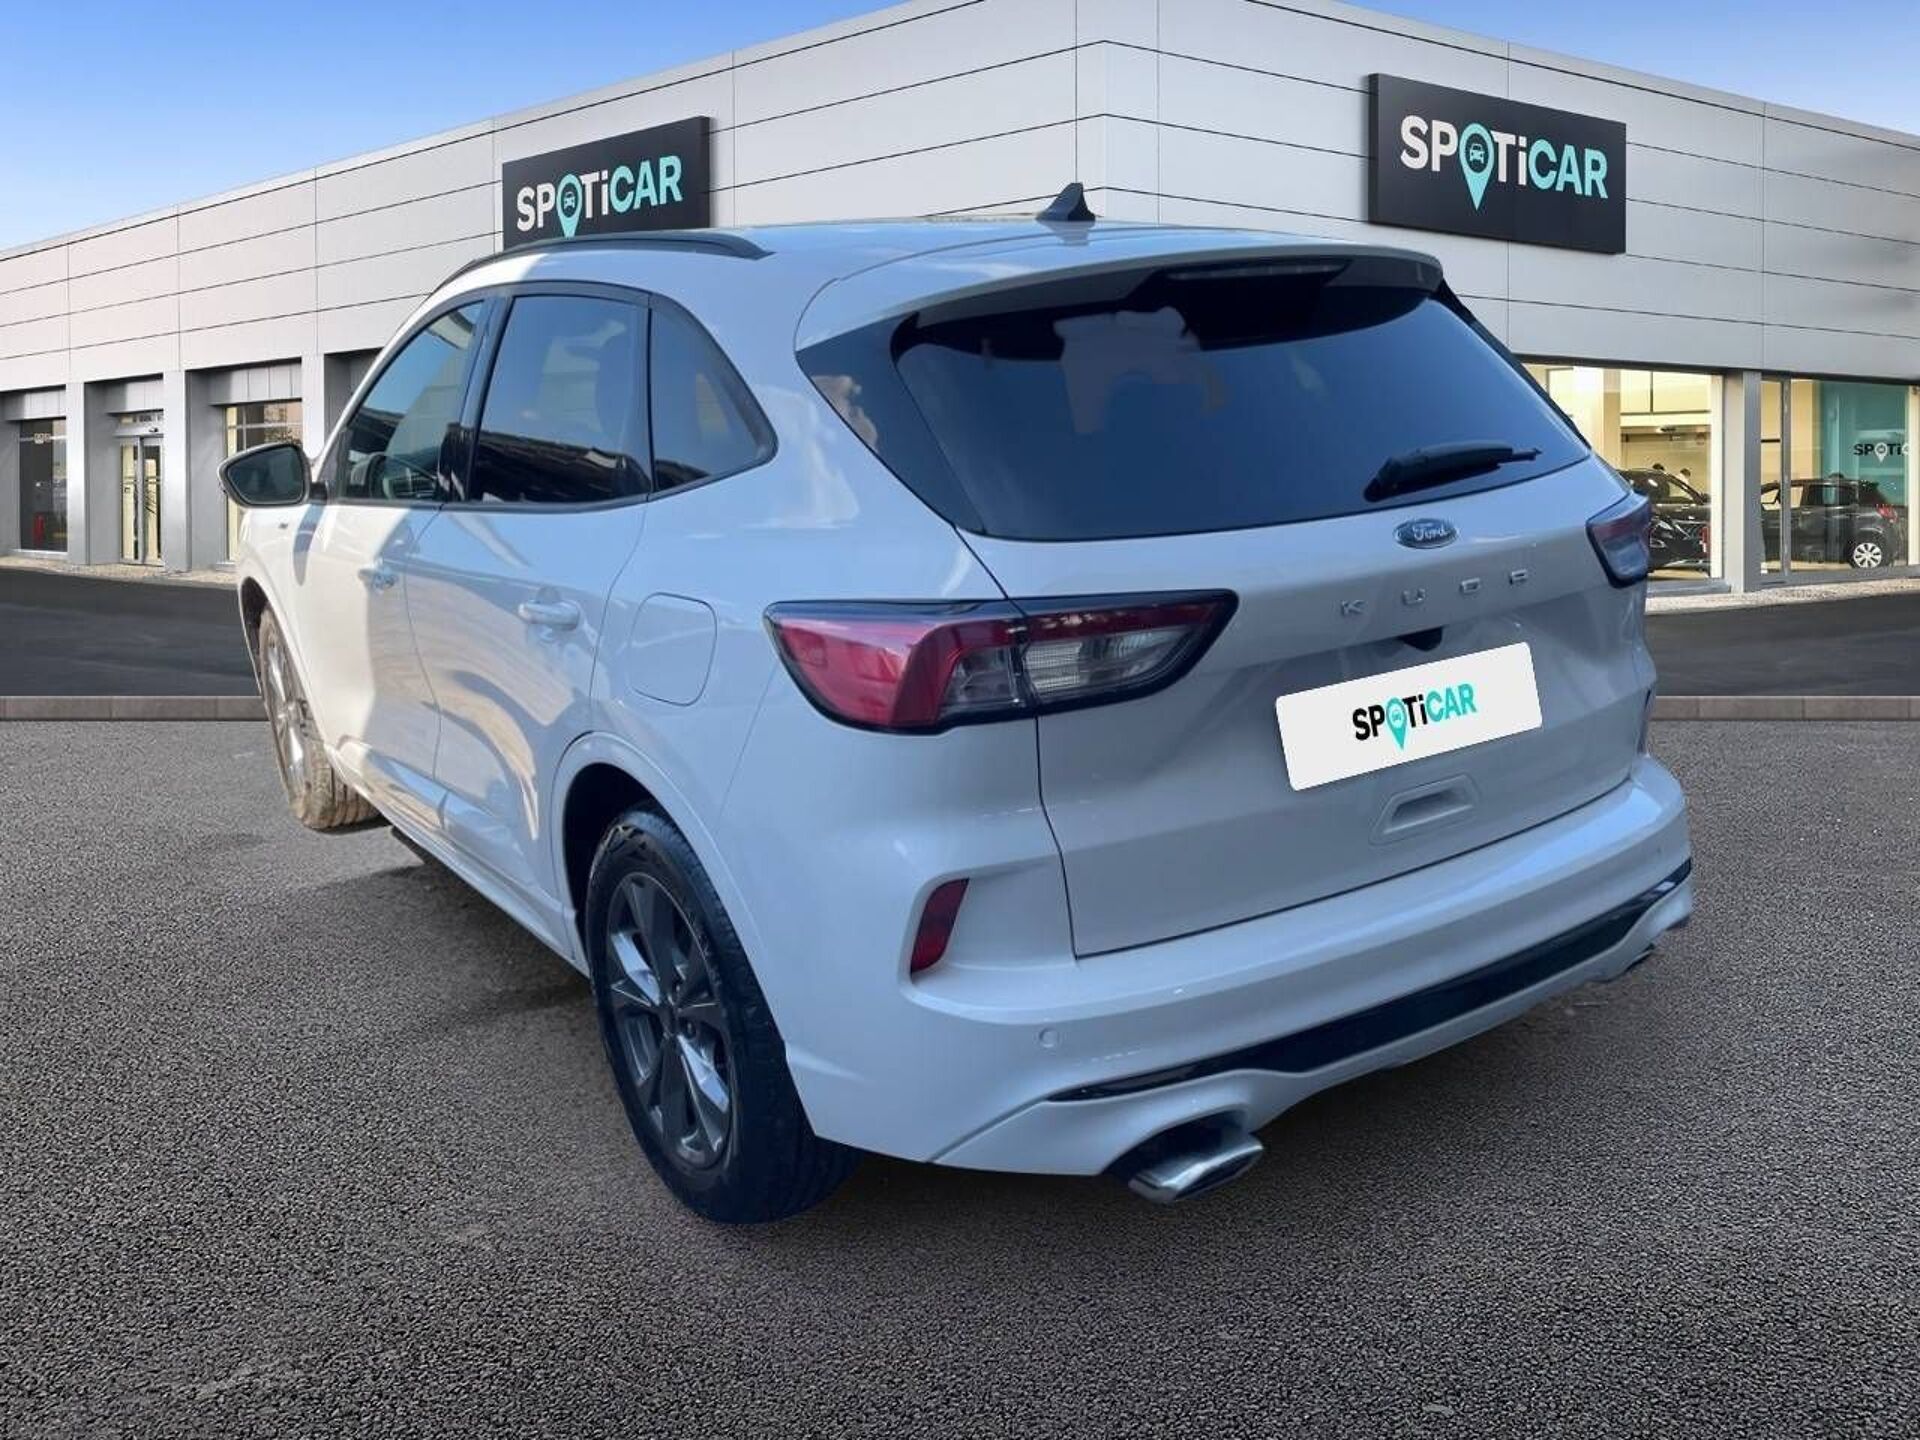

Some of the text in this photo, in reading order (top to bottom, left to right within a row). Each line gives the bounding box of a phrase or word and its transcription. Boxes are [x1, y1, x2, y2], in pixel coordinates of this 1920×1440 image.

[516, 155, 684, 239] SPOTiCAR
[1400, 115, 1609, 211] SPOTiCAR
[1411, 522, 1449, 541] Ford
[1352, 683, 1477, 750] SPOTiCAR
